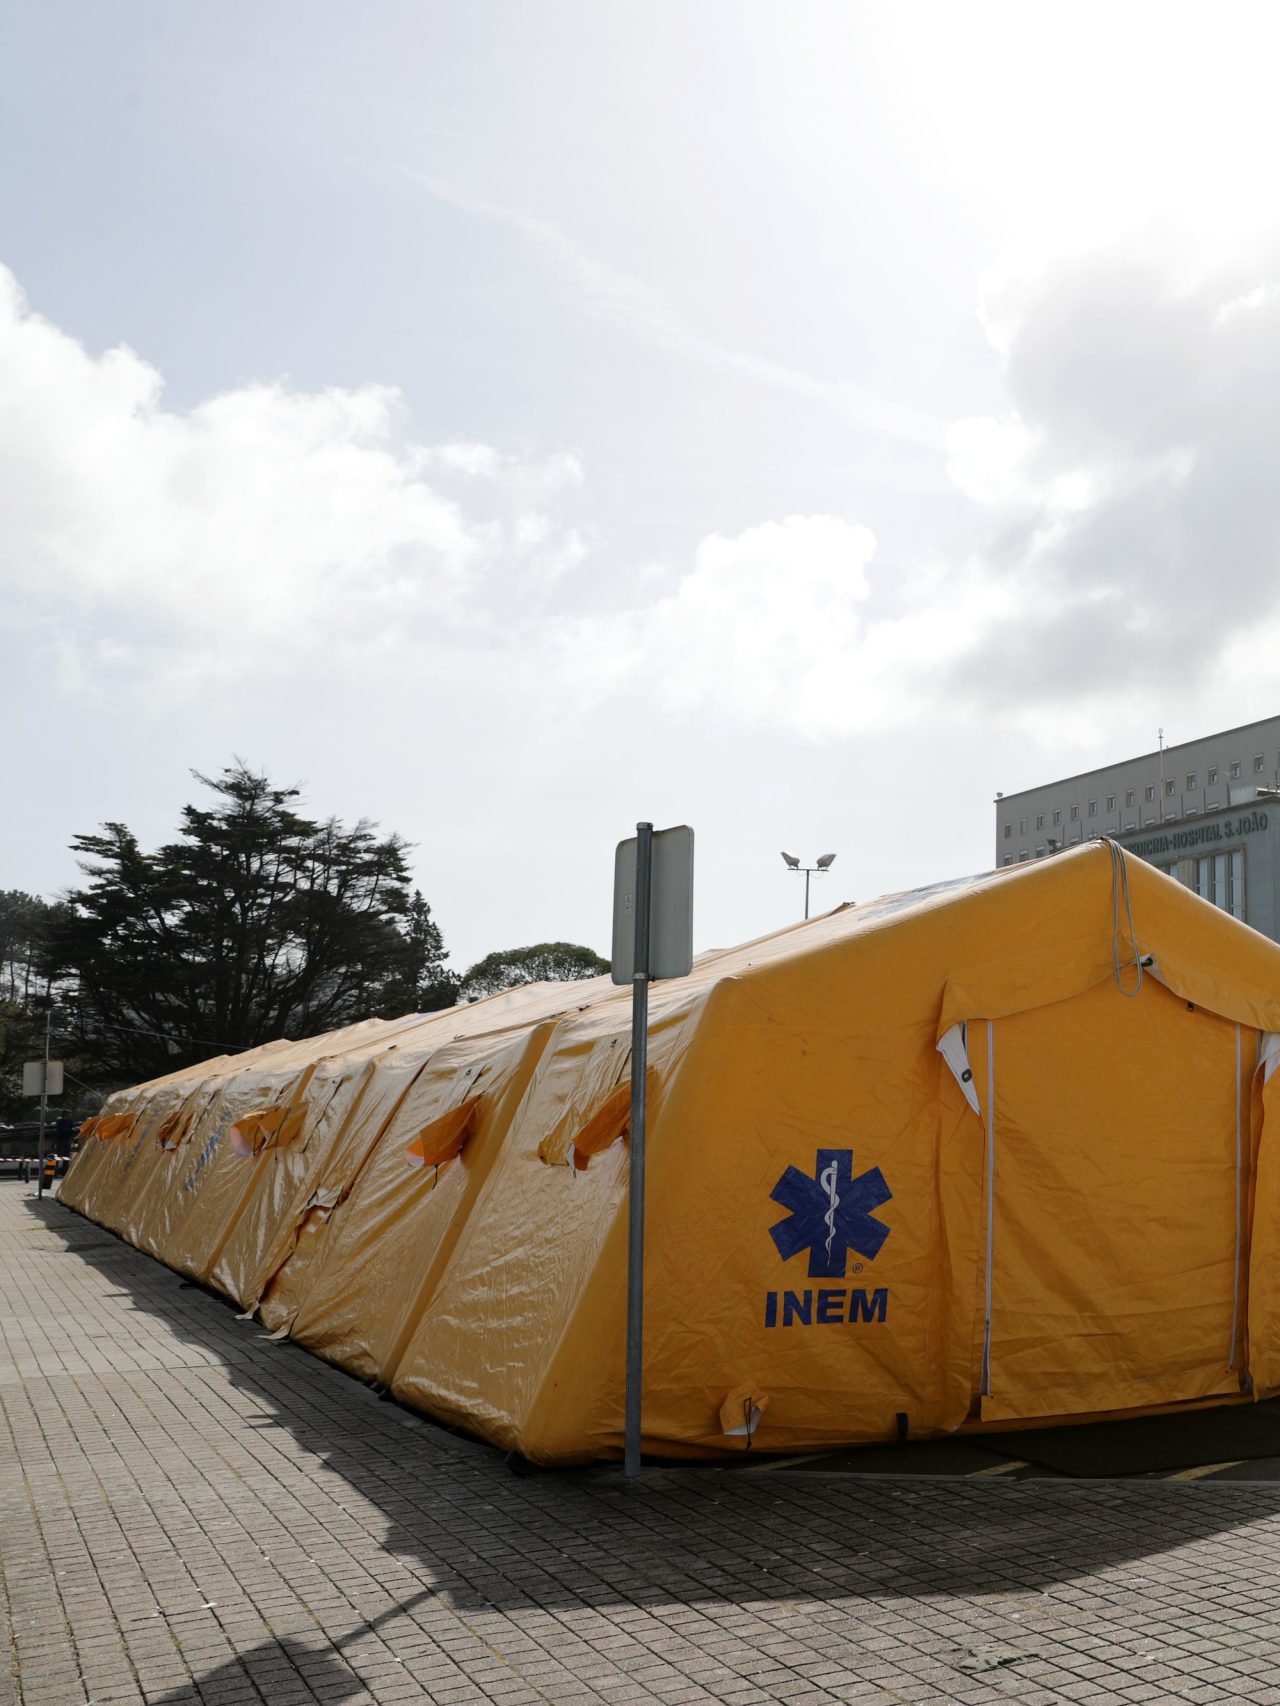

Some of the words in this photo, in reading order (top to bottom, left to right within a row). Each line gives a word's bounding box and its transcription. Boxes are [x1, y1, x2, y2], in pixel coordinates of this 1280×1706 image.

[1224, 820, 1234, 838] S.
[1236, 811, 1268, 835] JOÃO
[765, 1288, 889, 1328] INEM
